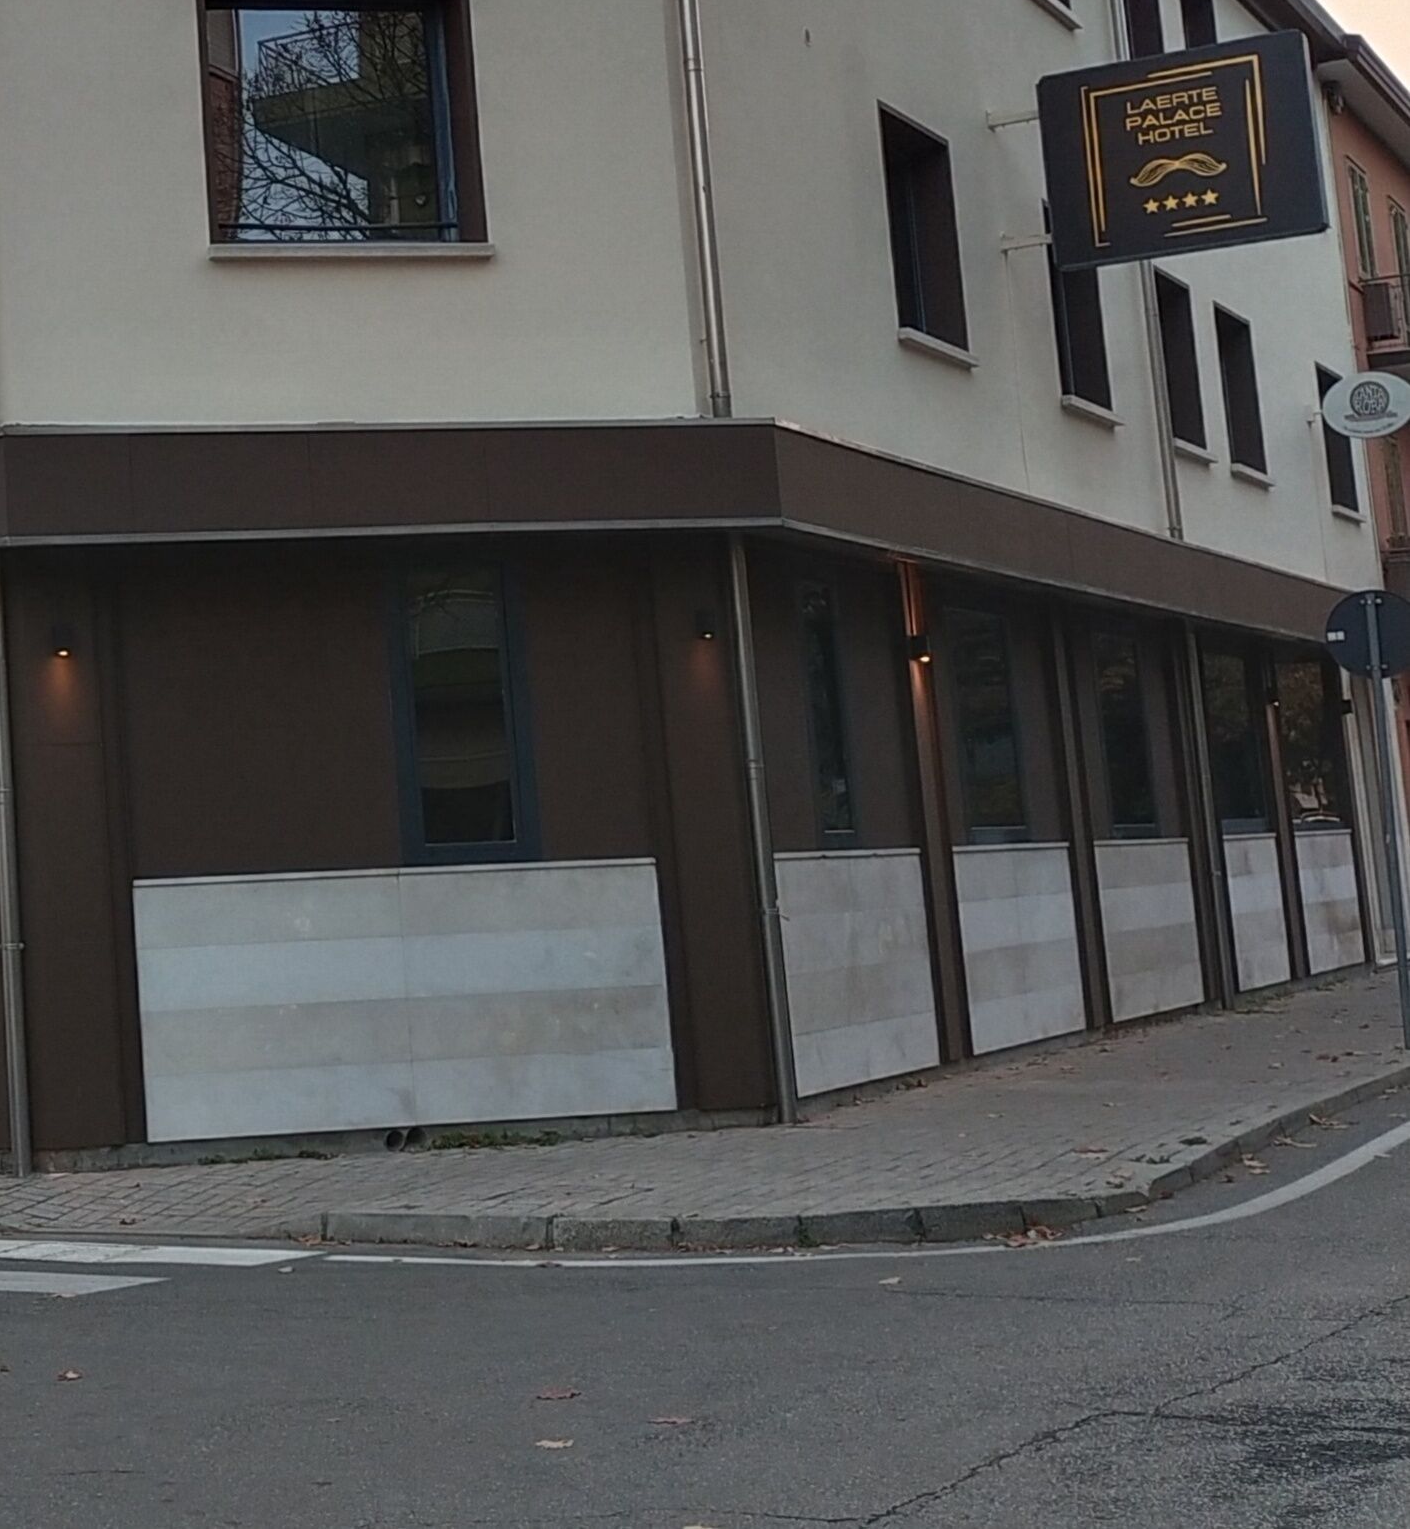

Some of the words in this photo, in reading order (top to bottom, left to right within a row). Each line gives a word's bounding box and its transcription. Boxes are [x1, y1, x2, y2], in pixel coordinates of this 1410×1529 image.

[1126, 86, 1218, 114] LAERTE
[1125, 102, 1222, 131] PALACE
[1137, 121, 1214, 145] HOTEL
